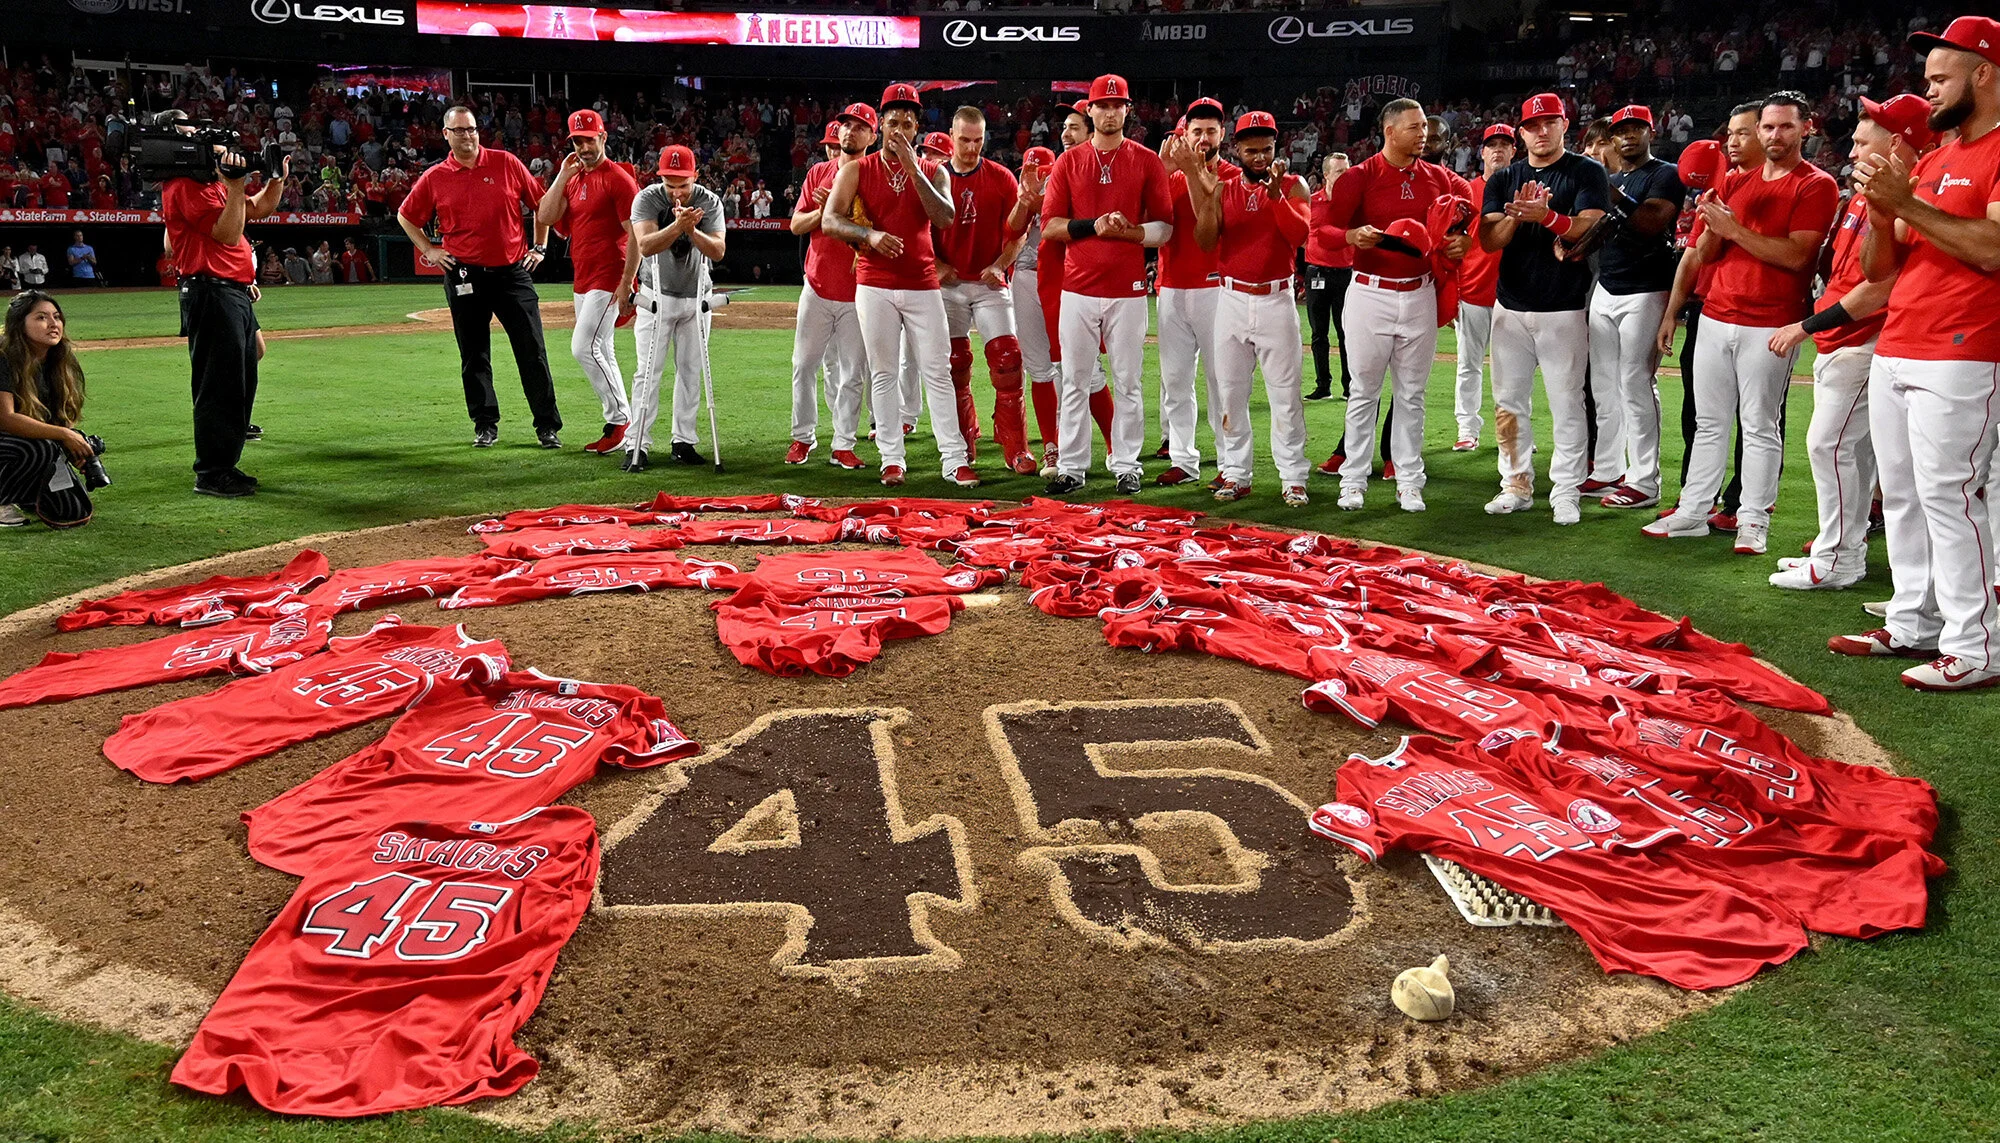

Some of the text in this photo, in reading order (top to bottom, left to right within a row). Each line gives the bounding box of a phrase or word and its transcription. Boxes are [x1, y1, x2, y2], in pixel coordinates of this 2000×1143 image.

[294, 3, 405, 25] LEXUS
[746, 13, 892, 46] ANGELS WIN
[980, 26, 1081, 41] LEXUS
[1308, 18, 1414, 37] LEXUS
[292, 662, 420, 708] 45
[1400, 671, 1519, 722] 45
[422, 712, 595, 779] 45
[598, 698, 1372, 980] 45
[1447, 793, 1597, 862] 45
[372, 831, 550, 880] SKAGGS
[302, 872, 514, 961] 45
